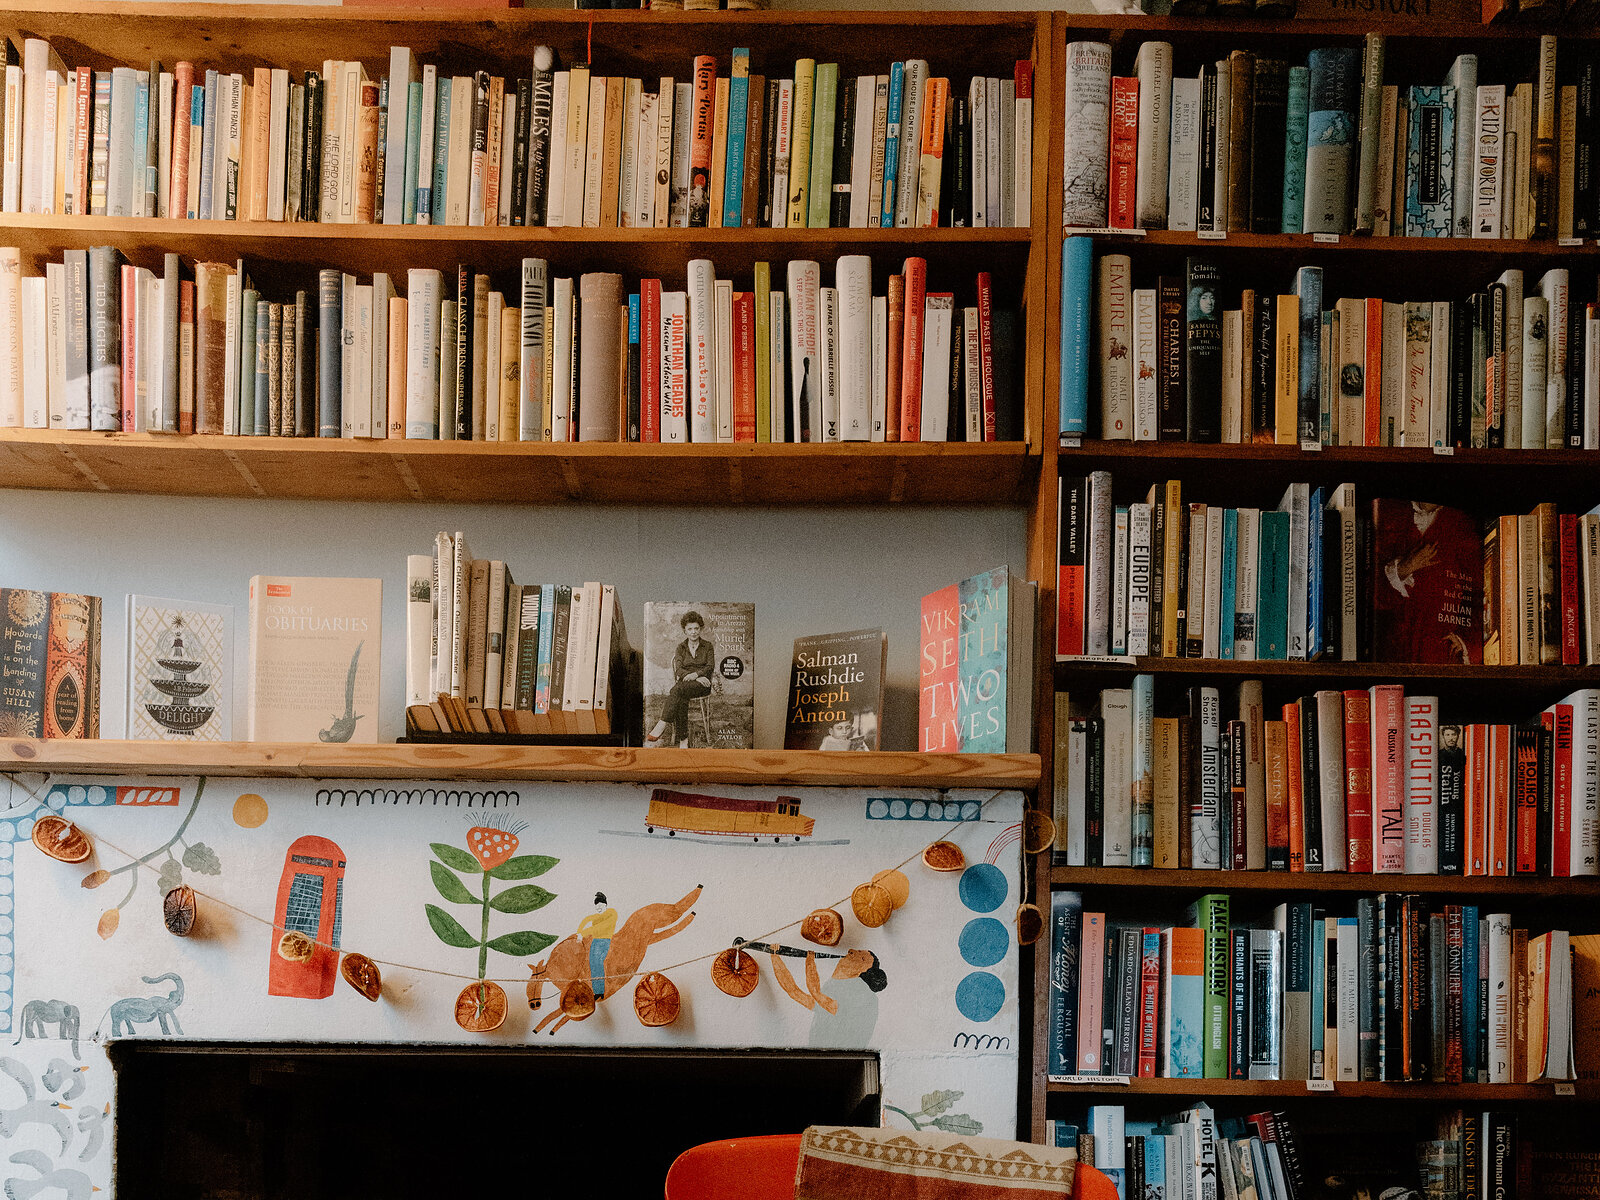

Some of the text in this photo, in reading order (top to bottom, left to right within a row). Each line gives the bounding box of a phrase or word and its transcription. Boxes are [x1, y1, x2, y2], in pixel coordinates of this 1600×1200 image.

[697, 62, 712, 140] Mary Portas
[782, 89, 788, 98] AN
[1152, 48, 1162, 123] MICHAEL WOOD
[230, 79, 240, 139] JONATHAN FRANZEN
[1480, 105, 1500, 145] KING
[533, 81, 551, 198] MILES In the Sixties
[1563, 95, 1574, 164] WARRIOR
[330, 135, 340, 200] THE LORD GOD
[1479, 155, 1498, 206] NORTH
[804, 270, 816, 356] SALMAN RUSHDIE
[982, 287, 990, 316] WHAT'S
[1109, 264, 1125, 332] EMPIRE
[97, 283, 105, 361] TED HUGHES
[696, 266, 709, 418] CAITLIN MORAN moranthology
[1139, 294, 1153, 358] EMPIRE
[1188, 330, 1220, 339] PEPYS
[672, 313, 684, 418] JONATHAN MEADES
[984, 344, 991, 352] IS
[968, 329, 978, 412] THE PUMP HOUSE GANG
[1110, 365, 1119, 413] FERGUSON
[1118, 376, 1127, 403] NIALL
[1410, 345, 1424, 425] In These Times
[1138, 382, 1147, 426] FERGUSON
[1132, 545, 1148, 603] EUROPE
[521, 595, 539, 630] WOUNDS
[923, 590, 1000, 635] VIKRAM
[1117, 597, 1123, 605] OF
[1437, 613, 1472, 627] BARNES
[1441, 603, 1472, 616] JULIAN
[4, 627, 43, 640] Howards
[265, 616, 369, 632] OBITUARIES
[714, 633, 746, 643] Muriel
[13, 655, 24, 664] on
[26, 655, 39, 665] the
[14, 640, 32, 654] End
[719, 642, 746, 652] Spark
[796, 652, 859, 669] Salman
[922, 621, 1000, 677] SETH
[3, 687, 36, 699] SUSAN
[792, 685, 850, 709] Joseph
[795, 668, 865, 687] Rushdie
[923, 669, 1001, 720] TWO
[6, 697, 32, 708] HILL
[158, 710, 205, 722] DELIGHT
[792, 708, 847, 723] Anton
[1202, 696, 1210, 725] Shorto
[923, 706, 1000, 753] LIVES
[1558, 714, 1570, 749] STALIN
[1410, 704, 1432, 806] RASPUTIN
[1586, 695, 1597, 811] THE LAST OF THE TSARS
[1202, 745, 1219, 817] Amsterdam
[1441, 765, 1452, 805] Stalin
[1452, 771, 1460, 800] Young
[1410, 817, 1419, 844] SMITH
[1422, 812, 1432, 848] DOUGLAS
[1209, 900, 1227, 998] FAKE HISTORY
[1236, 936, 1244, 980] MERCHANTS
[1123, 935, 1135, 1052] EDUARDO GALEANO MIRRORS
[1236, 983, 1243, 992] OF
[1213, 1005, 1222, 1049] OTTO ENGLISH
[1201, 1118, 1216, 1179] HOTEL K
[1496, 1125, 1506, 1142] The
[1495, 1144, 1506, 1184] Ottoman
